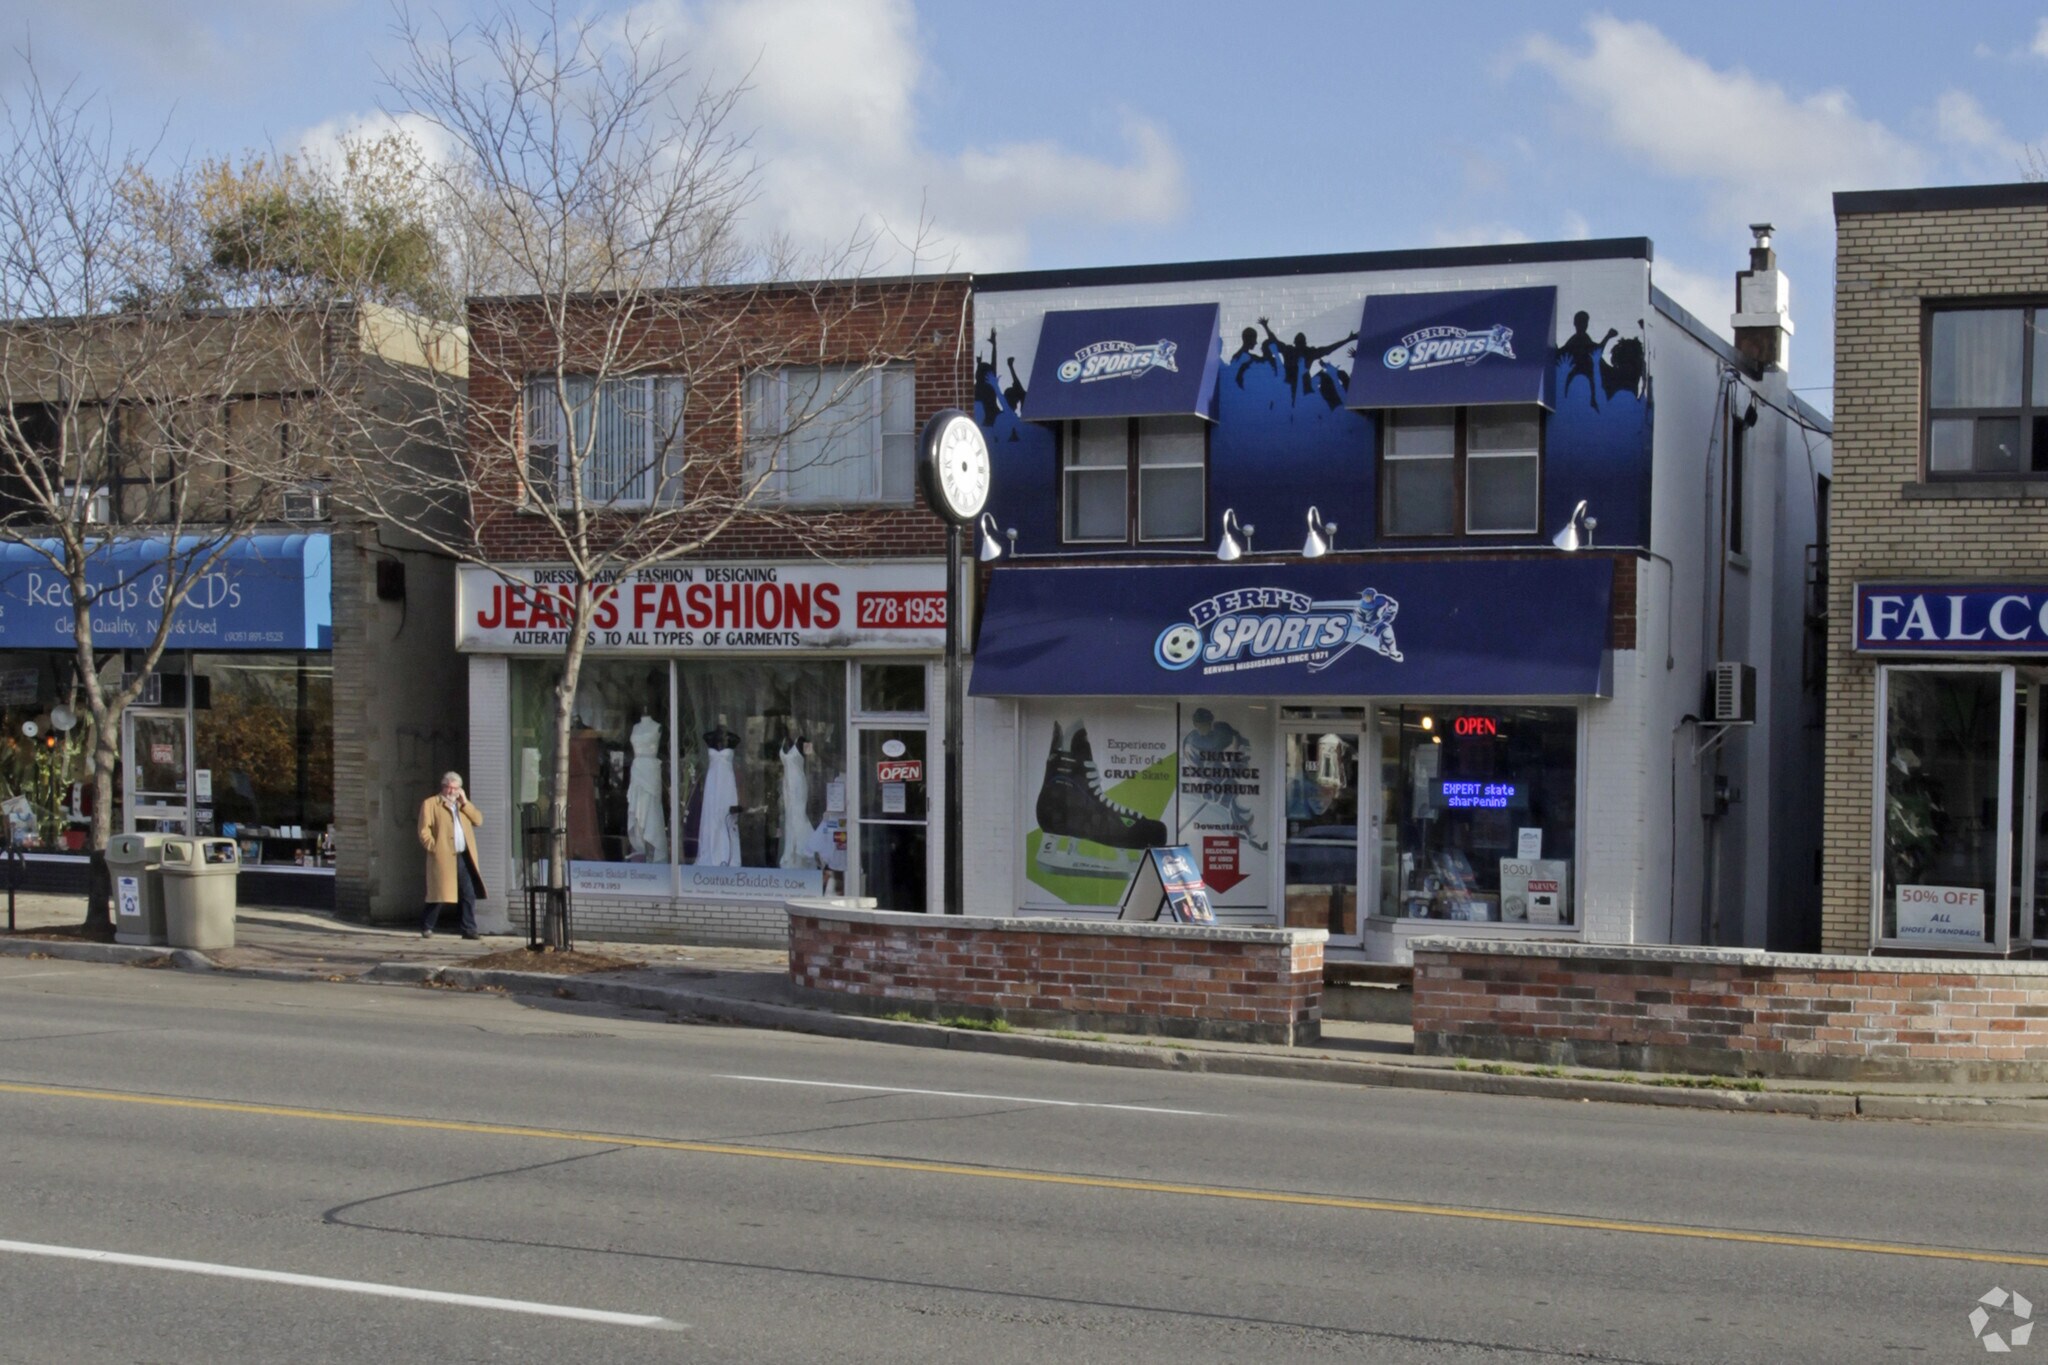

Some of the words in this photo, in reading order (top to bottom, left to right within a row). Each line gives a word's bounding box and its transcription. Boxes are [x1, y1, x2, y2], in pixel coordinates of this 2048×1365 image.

[1411, 339, 1486, 363] SPORTS
[1082, 352, 1152, 377] SPORTS
[534, 569, 626, 584] DRESSKING
[637, 568, 693, 583] FASHION
[705, 568, 777, 582] DESIGNING
[149, 574, 167, 608] &
[184, 572, 241, 609] CDs
[477, 583, 619, 630] JEAN'S
[633, 582, 841, 630] FASHIONS
[862, 597, 947, 624] 278-1953
[1190, 588, 1312, 627] BERT'S
[1866, 594, 2048, 641] FALC
[93, 616, 138, 638] Quality,
[147, 619, 174, 634] Nw
[176, 621, 186, 635] &
[188, 618, 217, 635] Used
[513, 631, 596, 646] ALTERATIS
[604, 631, 622, 646] TO
[626, 631, 649, 645] ALL
[653, 631, 694, 646] TYPES
[702, 631, 721, 646] OF
[726, 631, 800, 646] GARMENTS
[1203, 615, 1349, 662] SPORTS
[1203, 664, 1235, 675] SERVING
[1236, 657, 1286, 671] MISSISSAUGA
[1287, 654, 1310, 665] SINCE
[1311, 651, 1329, 661] 1971
[1455, 716, 1496, 736] OPEN
[1107, 739, 1166, 751] Experience
[1111, 754, 1127, 765] the
[1129, 754, 1143, 765] Fit
[1144, 754, 1155, 765] of
[1199, 751, 1243, 763] SKATE
[880, 766, 920, 780] OPEN
[1104, 769, 1138, 779] GRAF
[1142, 769, 1169, 780] Skate
[1182, 767, 1260, 779] EXCHANGE
[1181, 783, 1260, 795] EMPORIUM
[1443, 783, 1480, 795] EXPERT
[1484, 783, 1515, 796] skate
[1503, 864, 1533, 876] BOSU
[1902, 889, 1939, 904] 50%
[1944, 891, 1979, 906] OFF
[1930, 914, 1951, 923] ALL
[1935, 928, 1981, 937] HANDBAGS
